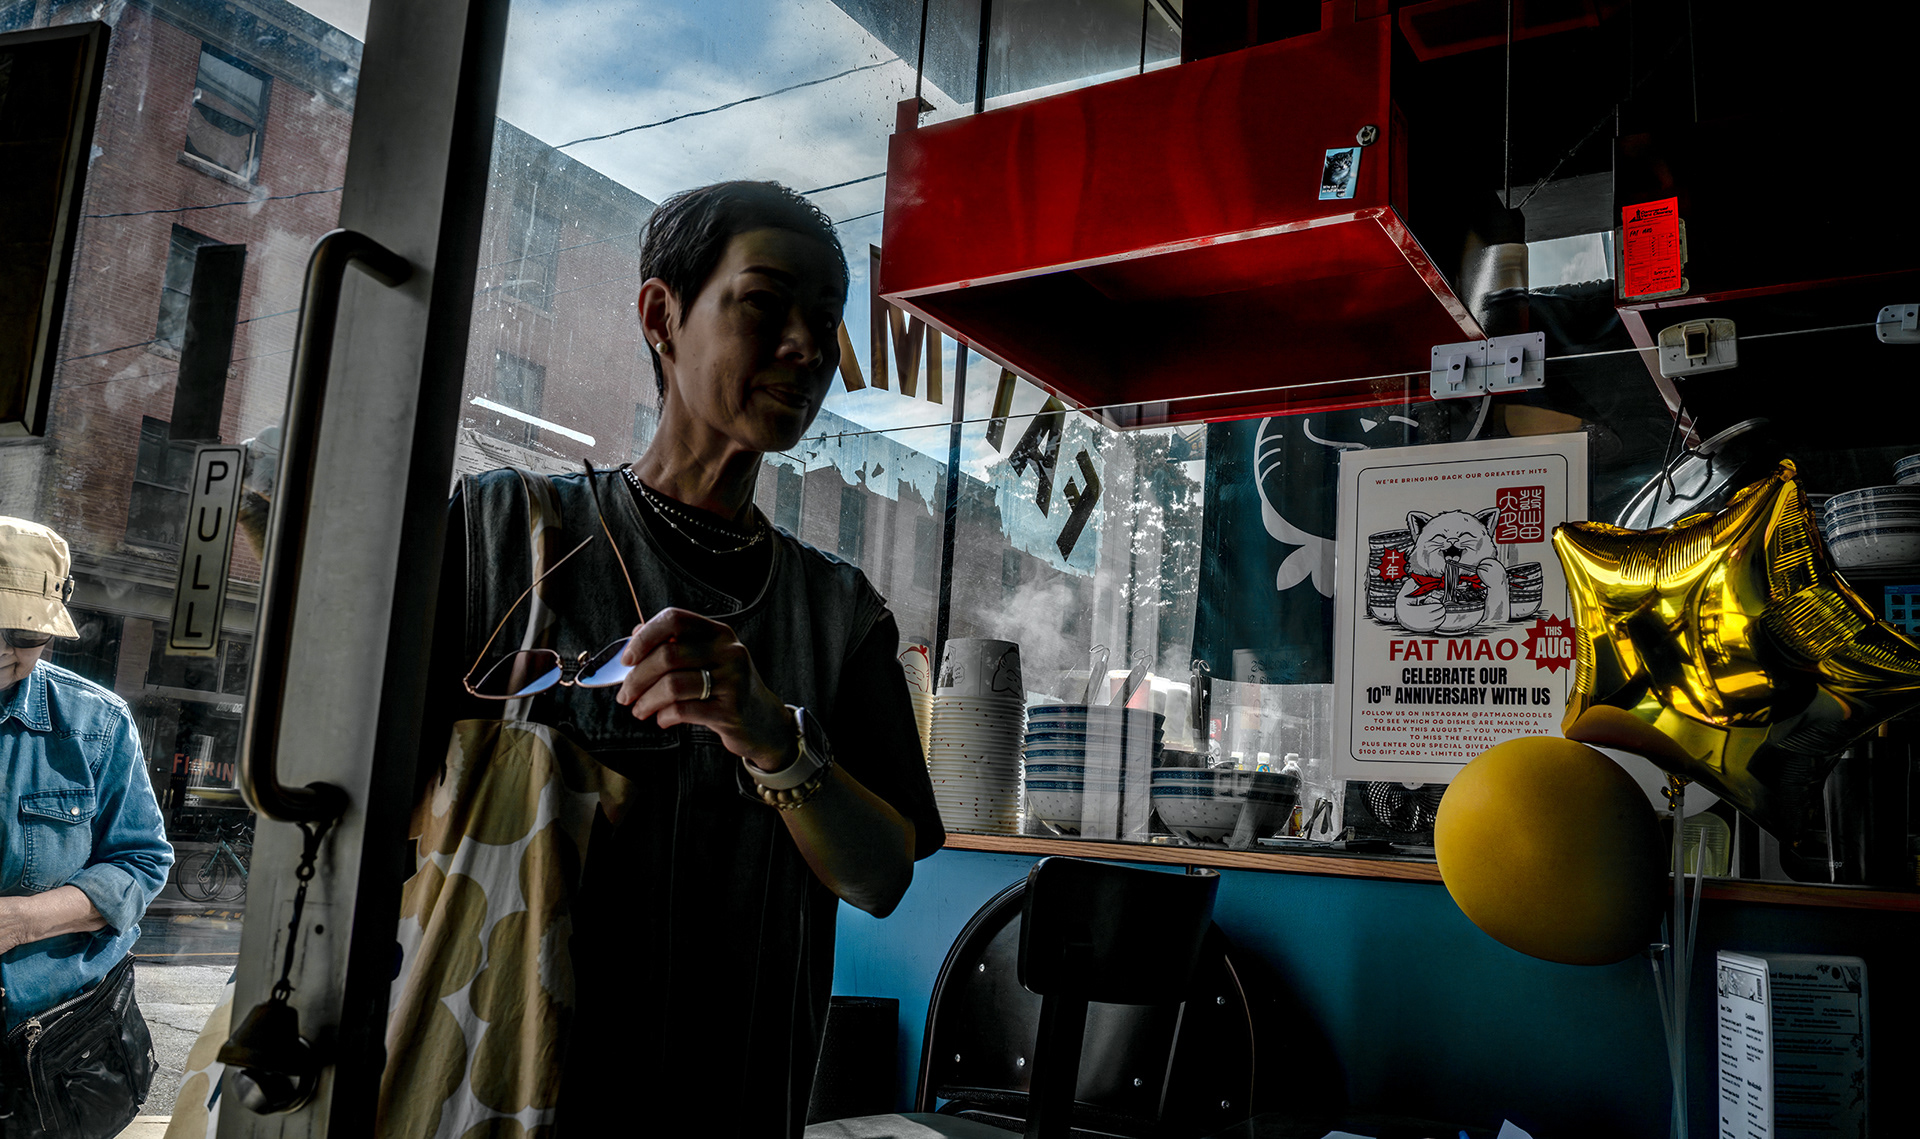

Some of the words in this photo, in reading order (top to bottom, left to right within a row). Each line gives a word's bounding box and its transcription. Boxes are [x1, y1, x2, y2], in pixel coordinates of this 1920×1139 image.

[1401, 475, 1439, 484] BRINGING
[1484, 469, 1526, 478] GREATEST
[184, 460, 229, 638] PULL
[1386, 552, 1400, 579] 十年
[1544, 626, 1562, 636] THIS
[1389, 639, 1439, 662] FAT
[1446, 638, 1519, 661] MAO
[1535, 637, 1572, 659] AUG
[1402, 667, 1475, 684] CELEBRATE
[1479, 667, 1507, 684] OUR
[1366, 686, 1391, 704] 10TH
[1395, 687, 1487, 705] ANNIVERSARY
[1491, 687, 1526, 705] WITH
[1532, 688, 1550, 705] US
